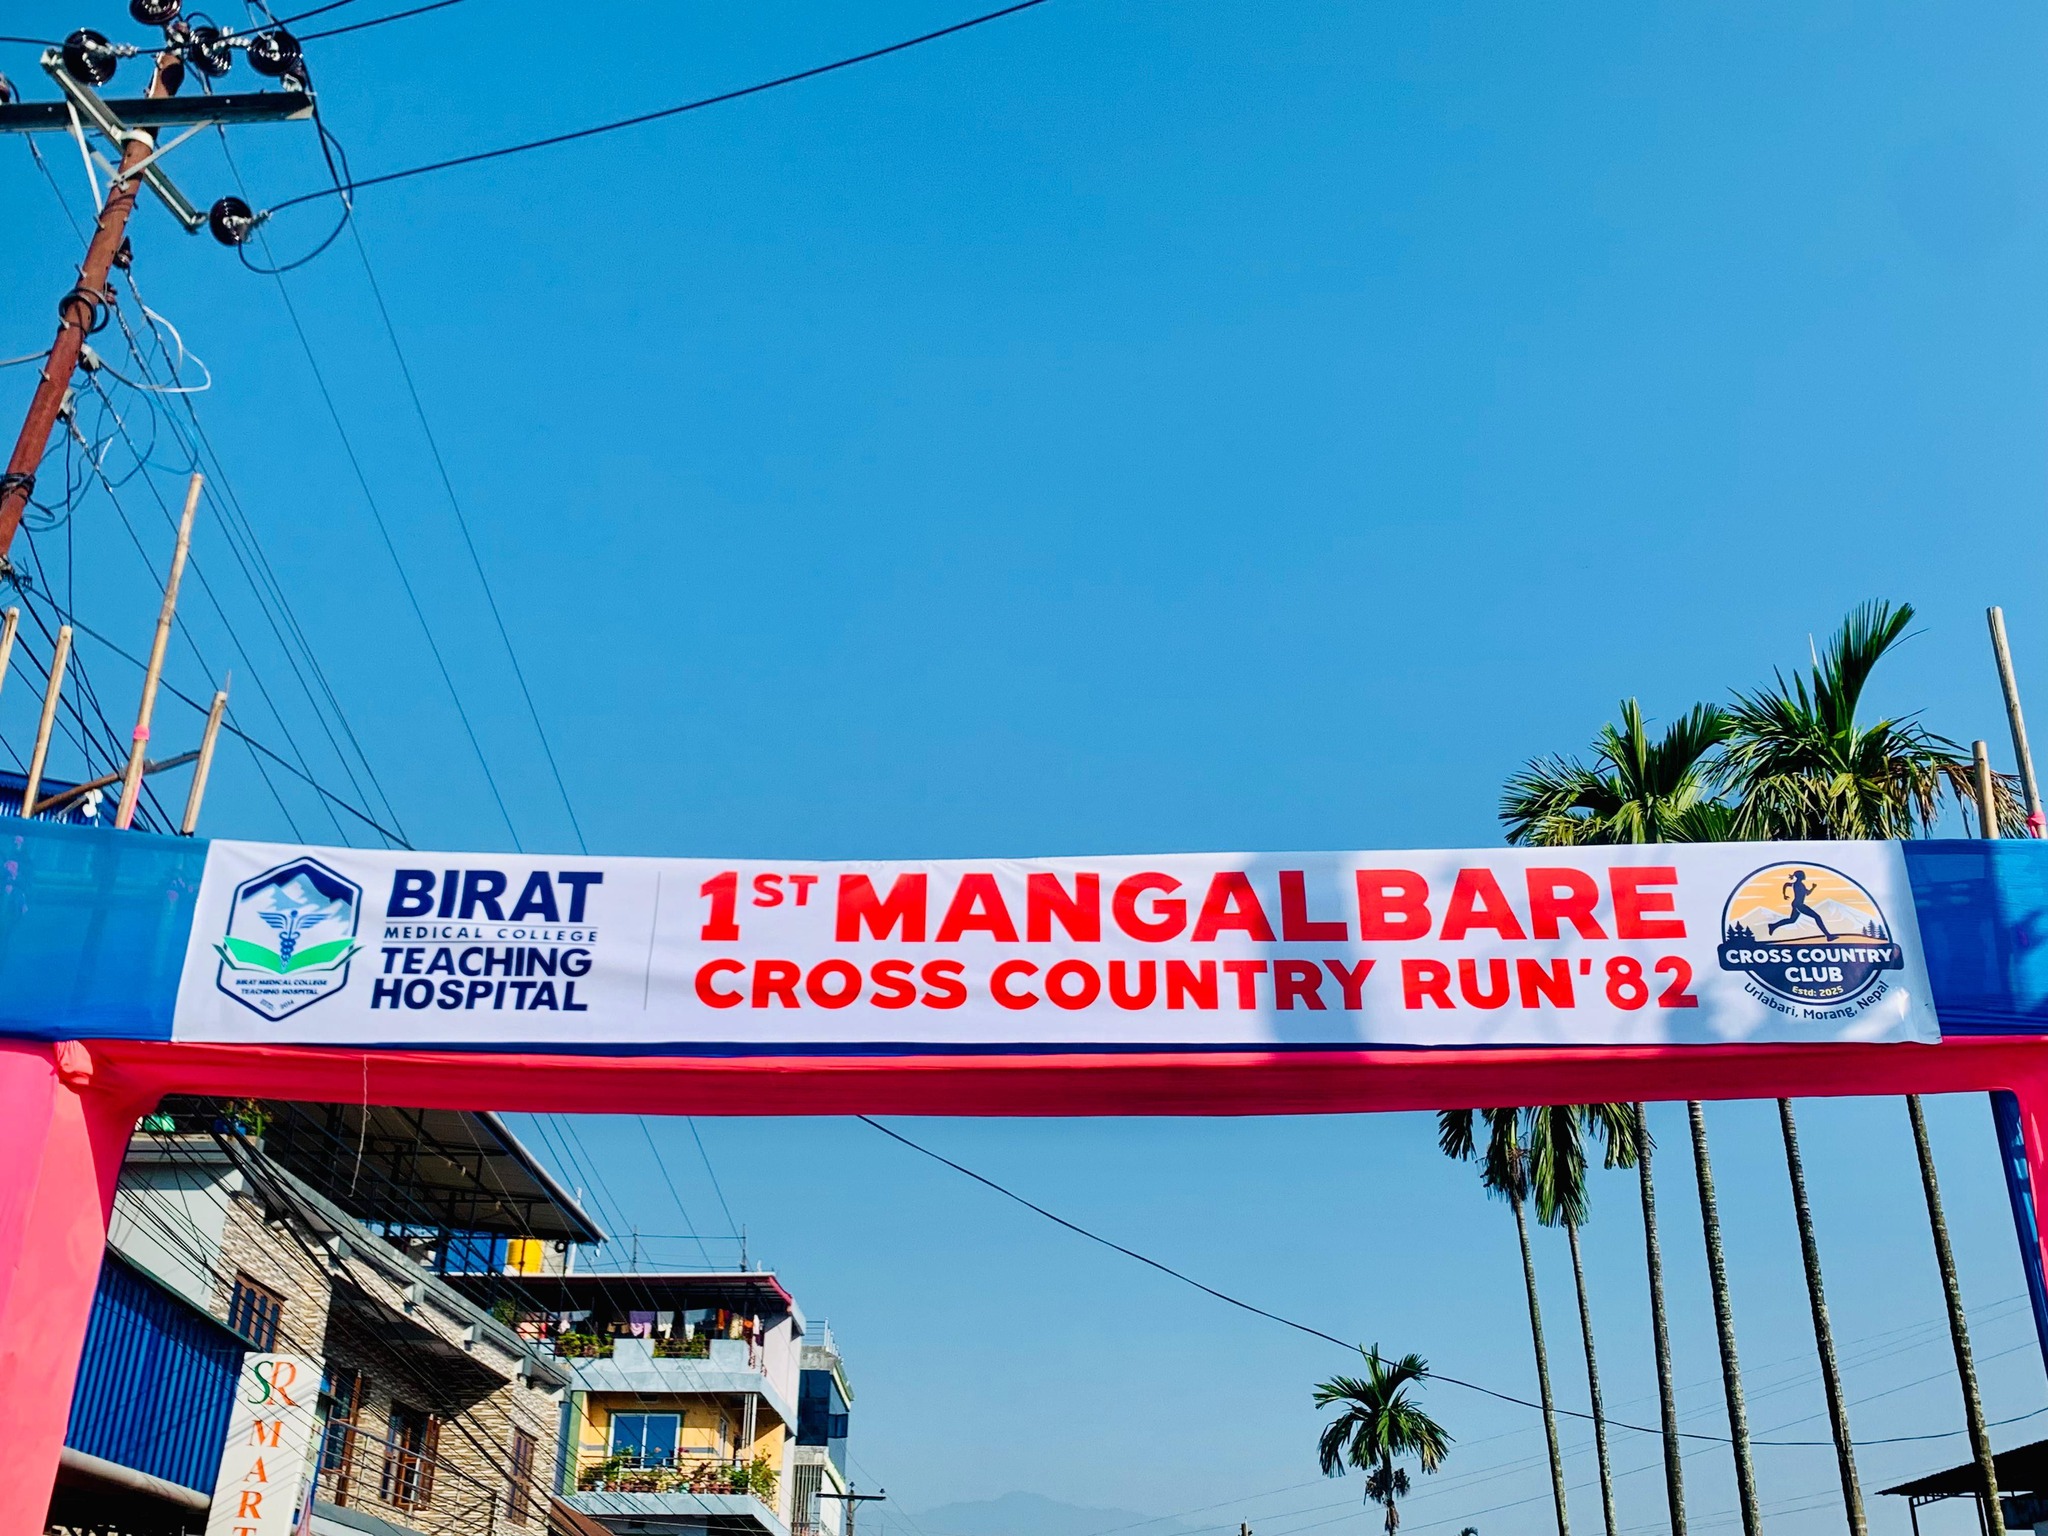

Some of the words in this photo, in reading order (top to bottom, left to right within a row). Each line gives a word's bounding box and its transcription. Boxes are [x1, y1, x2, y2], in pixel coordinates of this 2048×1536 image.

[386, 869, 604, 923] BIRAT
[699, 871, 818, 941] 1ST
[835, 867, 1687, 943] MANGALBARE
[384, 926, 482, 940] MEDICAL
[497, 928, 598, 943] COLLEGE
[381, 947, 593, 977] TEACHING
[1726, 949, 1793, 963] CROSS
[1796, 948, 1892, 963] COUNTRY
[694, 958, 968, 1010] CROSS
[989, 958, 1377, 1011] COUNTRY
[1784, 966, 1844, 983] CLUB
[370, 978, 588, 1011] HOSPITAL
[1744, 981, 1799, 1018] Urlabari,
[1803, 1005, 1858, 1020] Morang,
[1856, 980, 1890, 1010] Nepal
[1791, 985, 1817, 998] Estd:
[1819, 985, 1844, 998] 2025
[247, 1360, 300, 1407] SR
